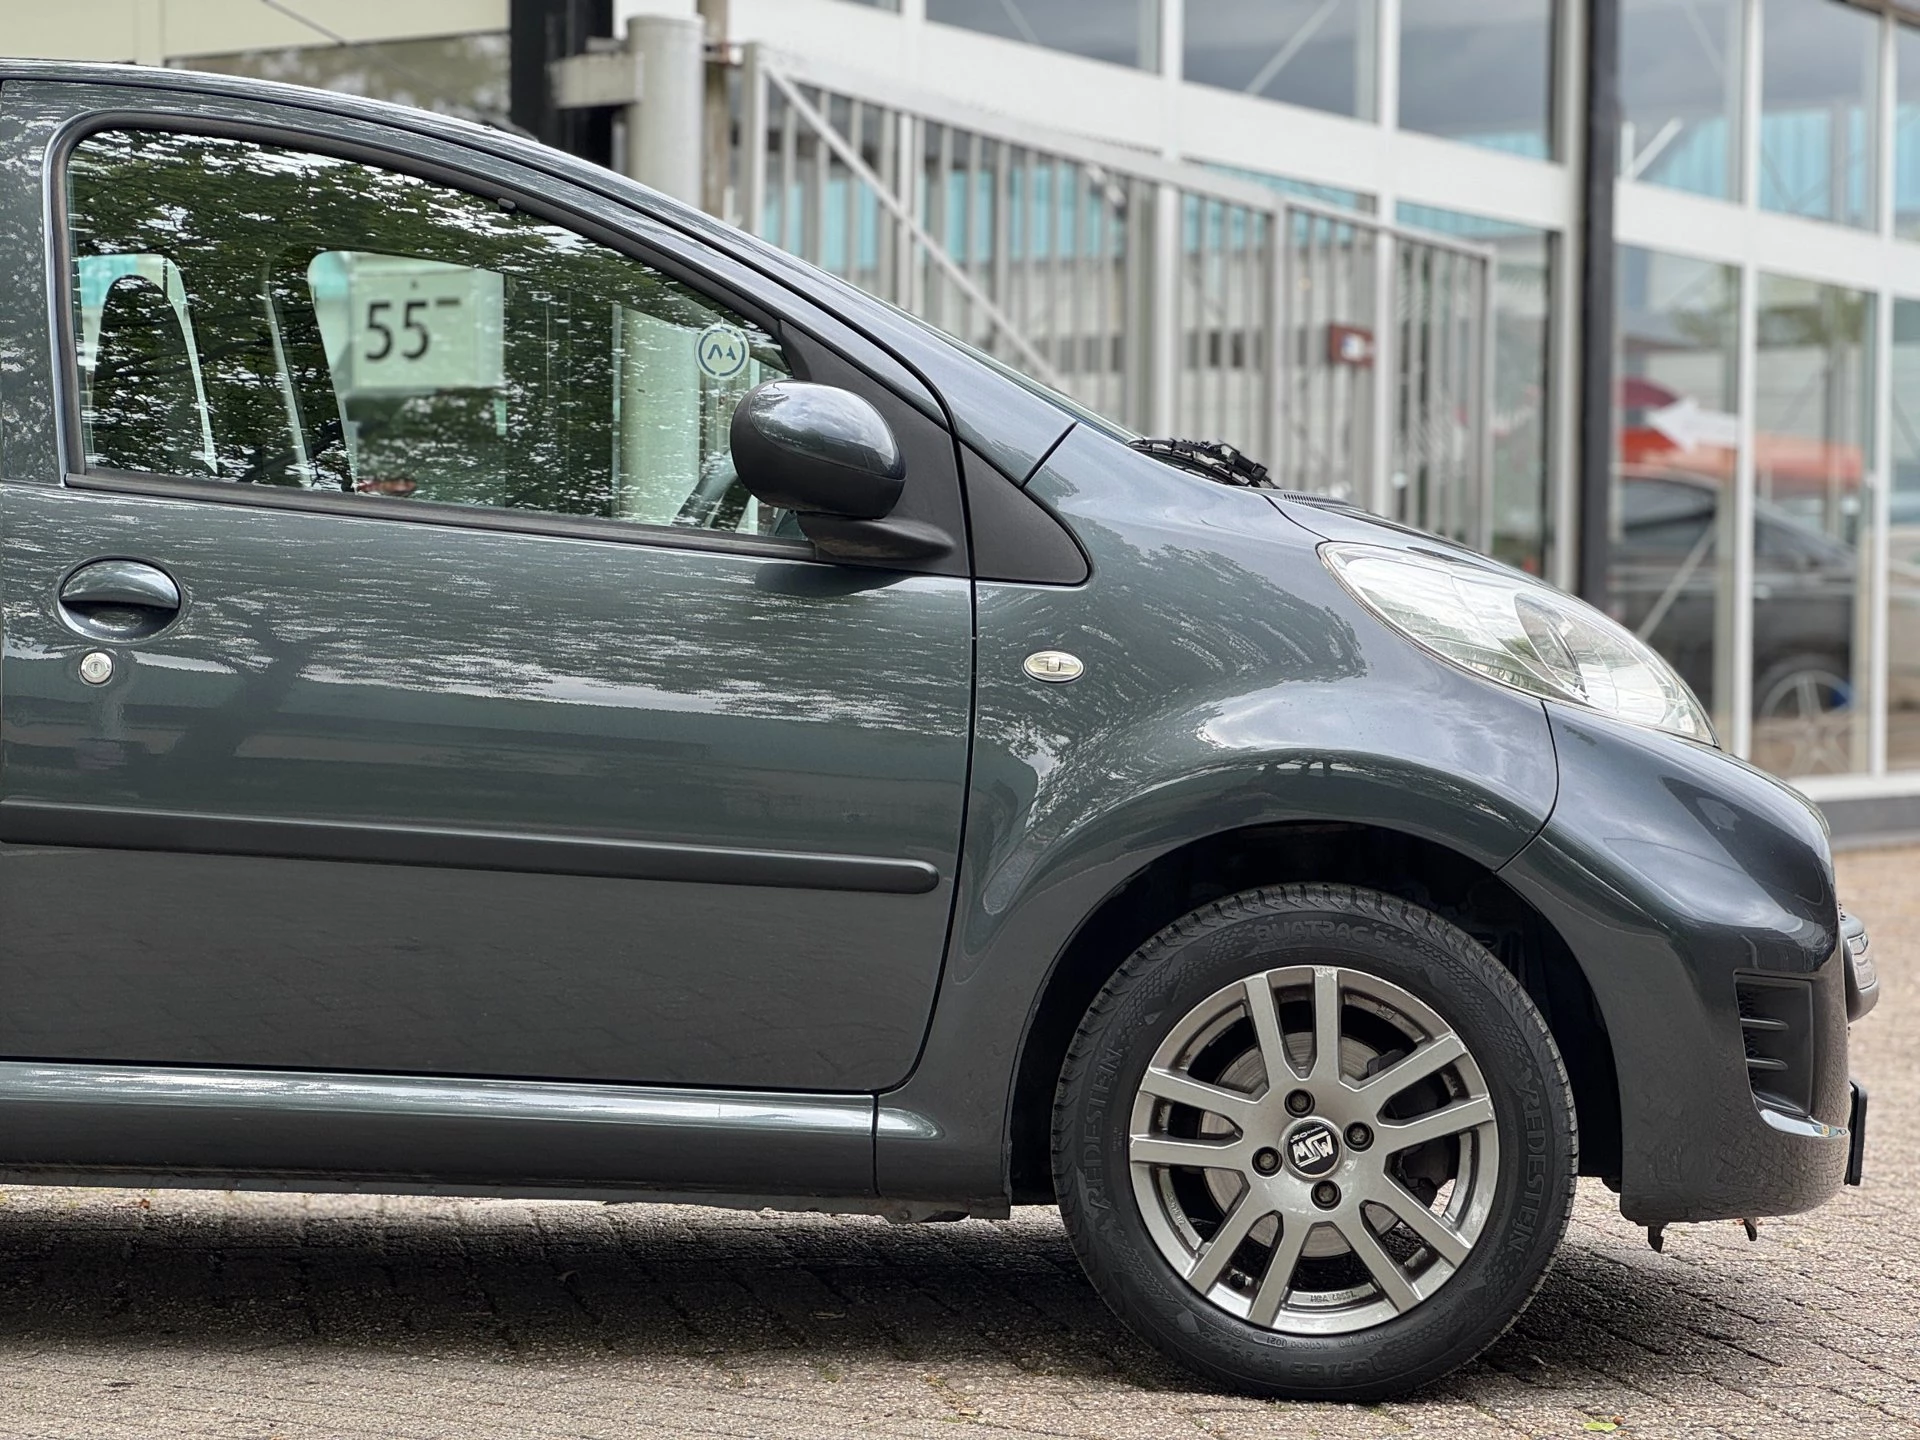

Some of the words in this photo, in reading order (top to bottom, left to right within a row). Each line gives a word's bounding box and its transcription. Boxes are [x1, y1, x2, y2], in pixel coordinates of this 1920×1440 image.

[1253, 920, 1369, 945] QUATRAC
[1374, 930, 1388, 948] 5
[1084, 1048, 1123, 1230] VREDESTEIN
[1292, 1130, 1334, 1168] MSW
[1507, 1067, 1547, 1252] VREDESTEIN
